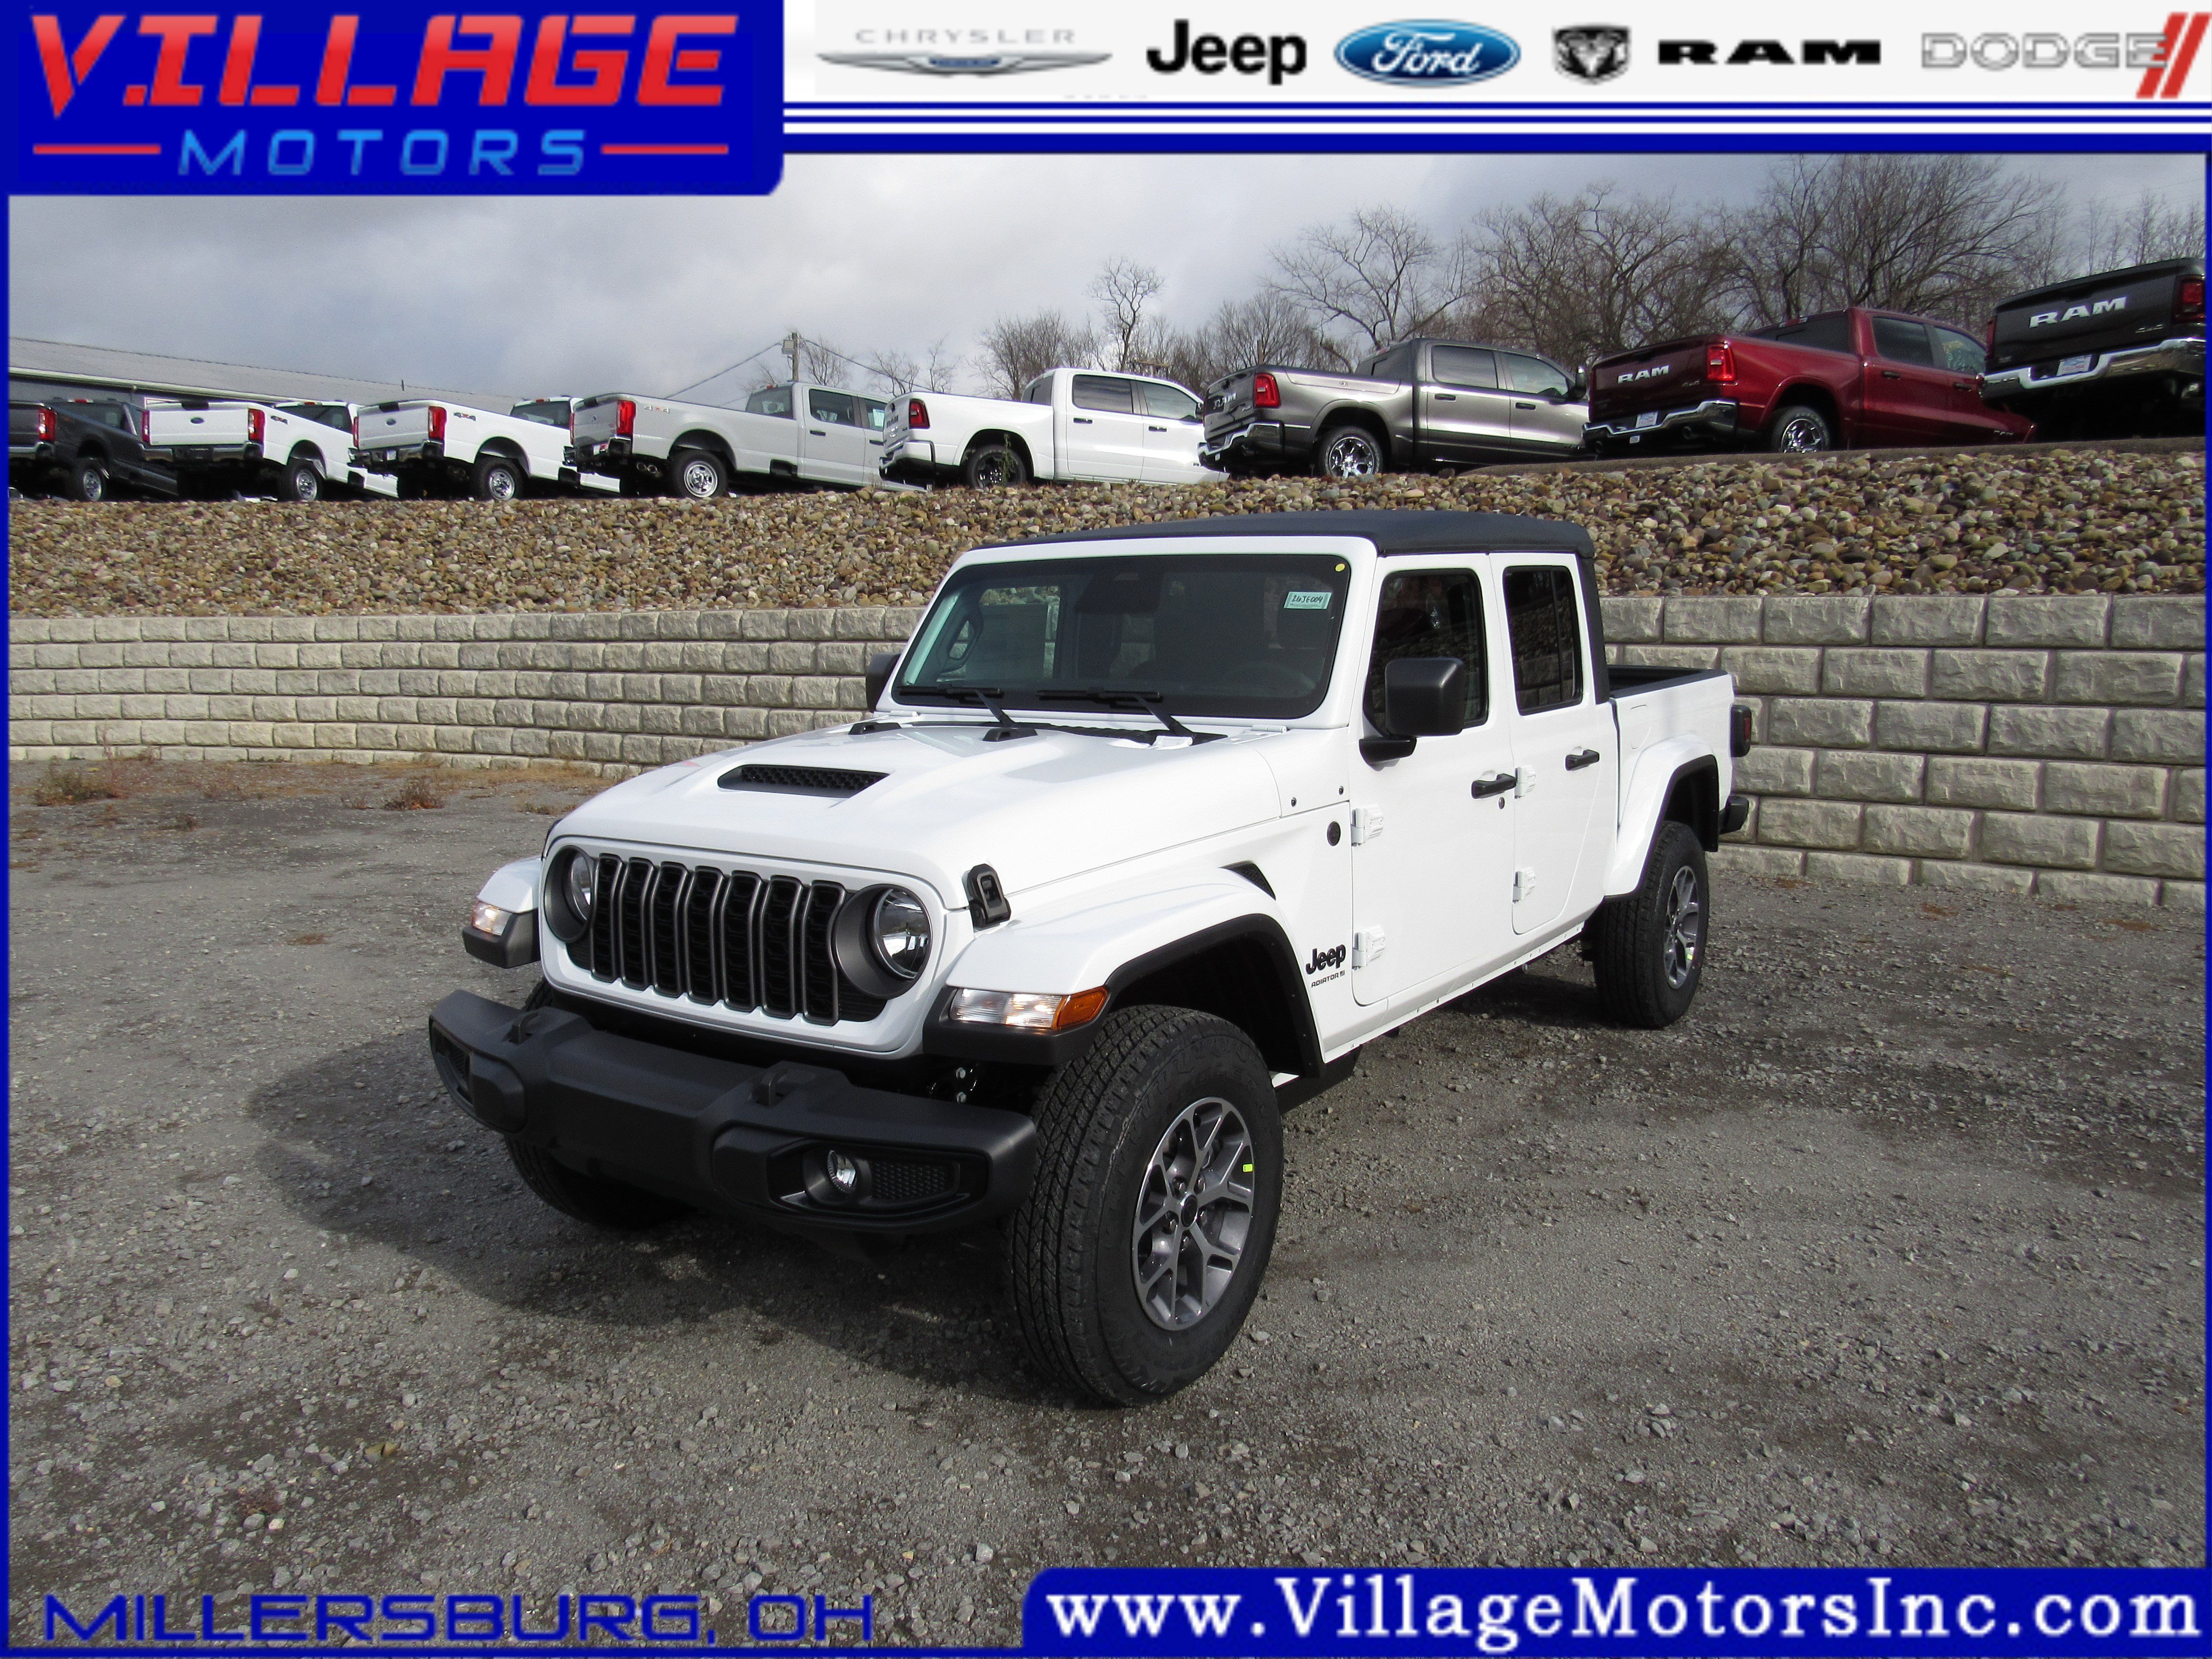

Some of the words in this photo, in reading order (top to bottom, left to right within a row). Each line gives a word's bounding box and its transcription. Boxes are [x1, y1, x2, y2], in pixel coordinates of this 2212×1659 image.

[2029, 296, 2127, 328] RAM
[1617, 365, 1670, 384] RAM
[1306, 944, 1346, 974] Jeep
